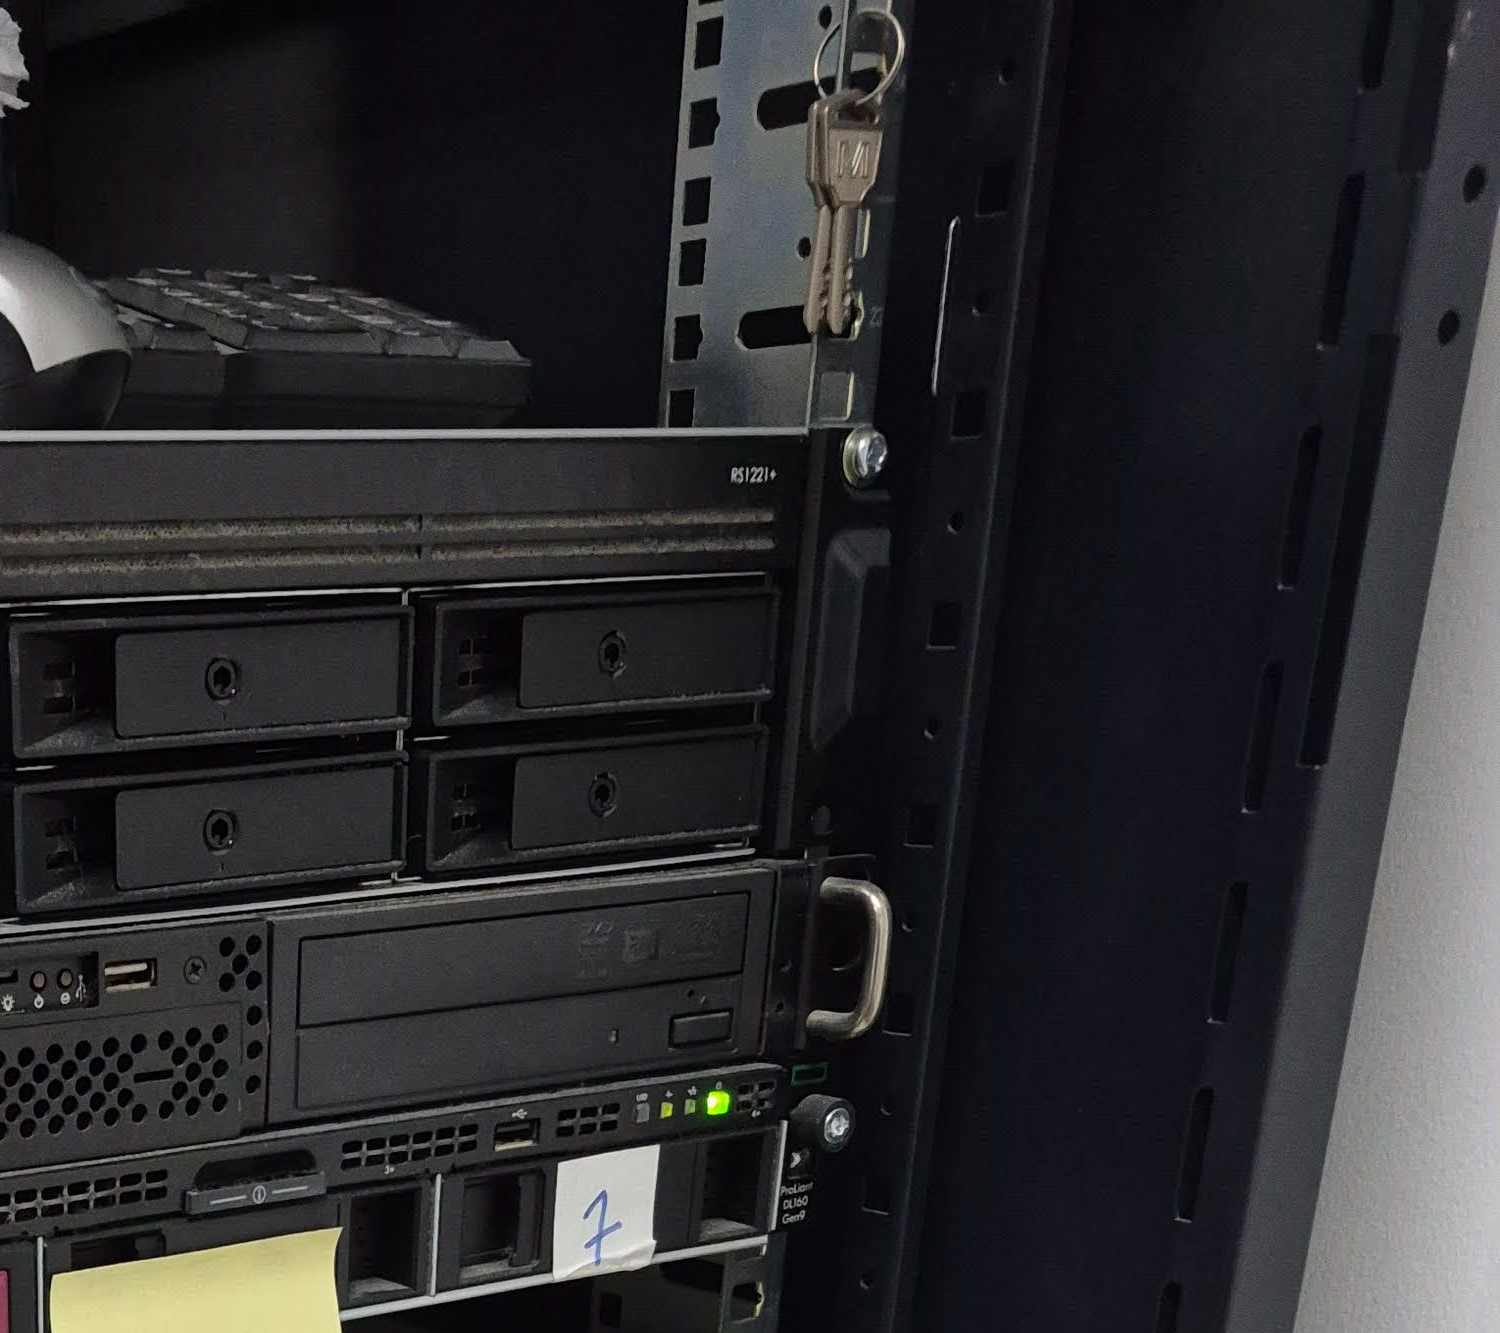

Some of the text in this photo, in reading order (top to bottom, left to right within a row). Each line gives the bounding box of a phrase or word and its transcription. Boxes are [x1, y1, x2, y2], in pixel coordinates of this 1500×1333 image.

[782, 1195, 809, 1211] DL160
[781, 1210, 807, 1225] Gen9
[582, 1188, 622, 1267] 7
